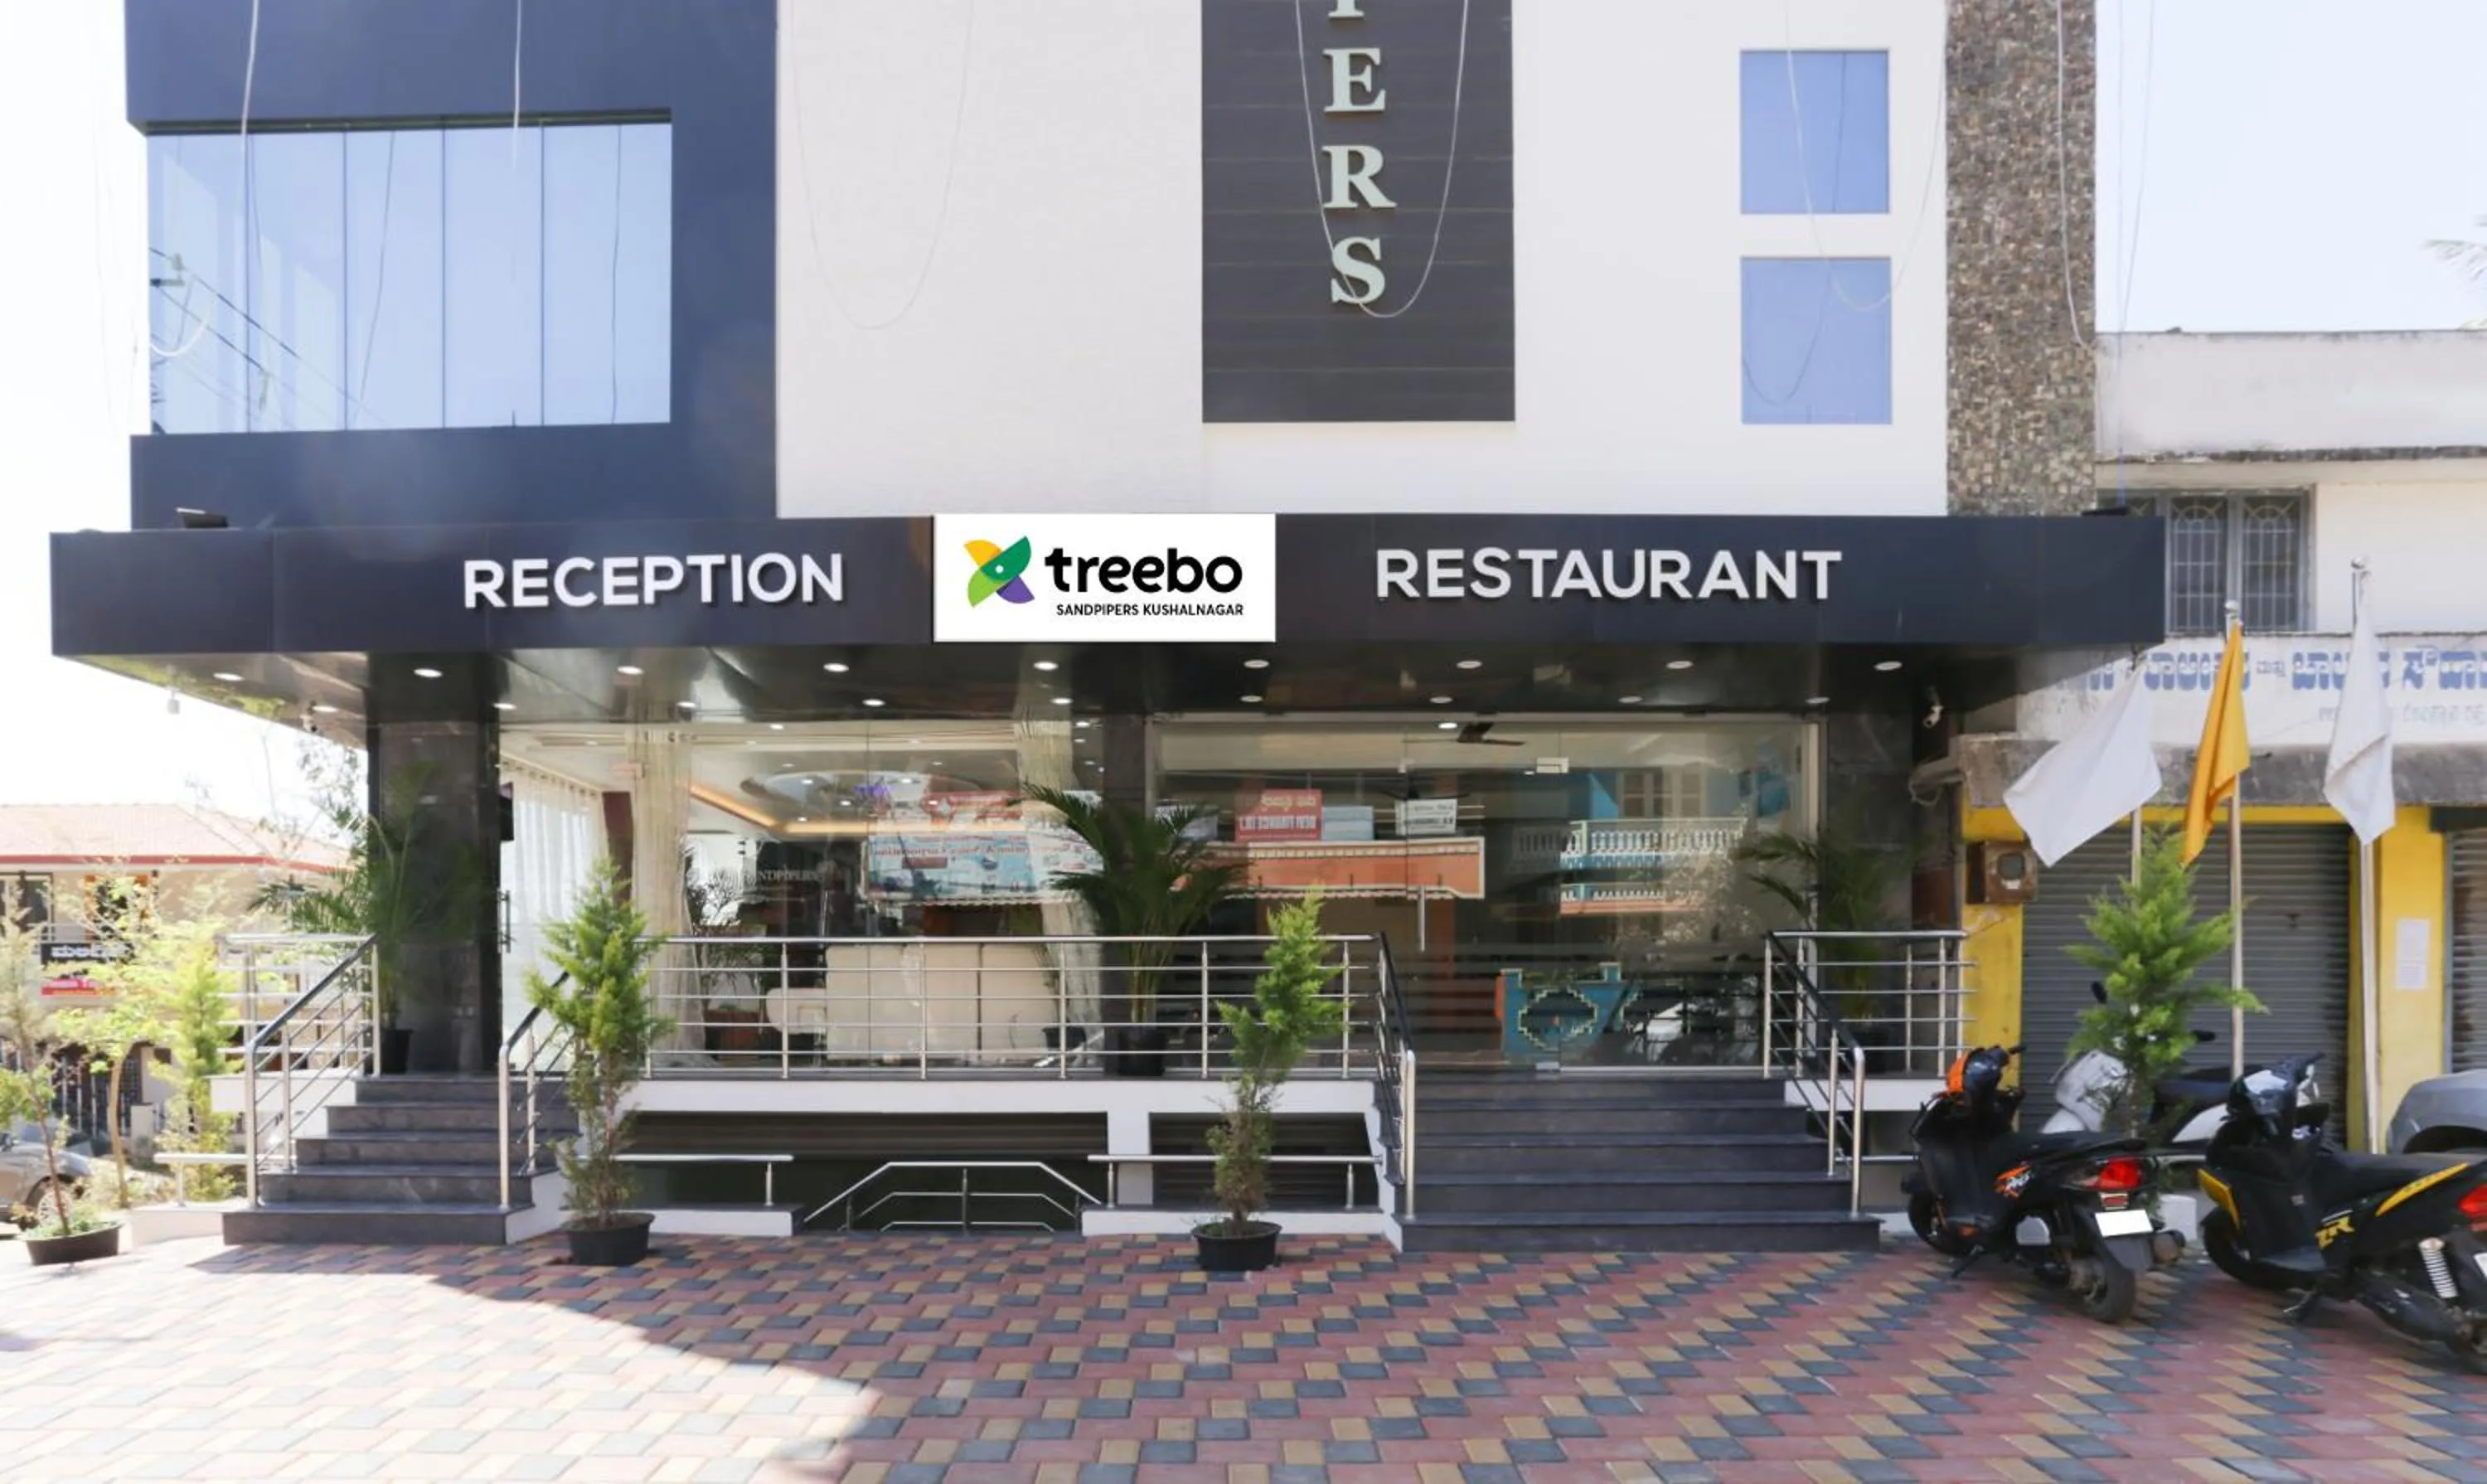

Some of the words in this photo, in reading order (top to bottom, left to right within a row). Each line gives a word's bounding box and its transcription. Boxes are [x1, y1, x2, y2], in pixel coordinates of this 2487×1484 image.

[1321, 0, 1398, 305] ERS
[464, 552, 843, 609] RECEPTION
[1045, 547, 1243, 594] treebo
[1376, 546, 1843, 599] RESTAURANT
[1056, 604, 1139, 616] SANDPIPERS
[1143, 604, 1244, 616] KUSHALNAGAR
